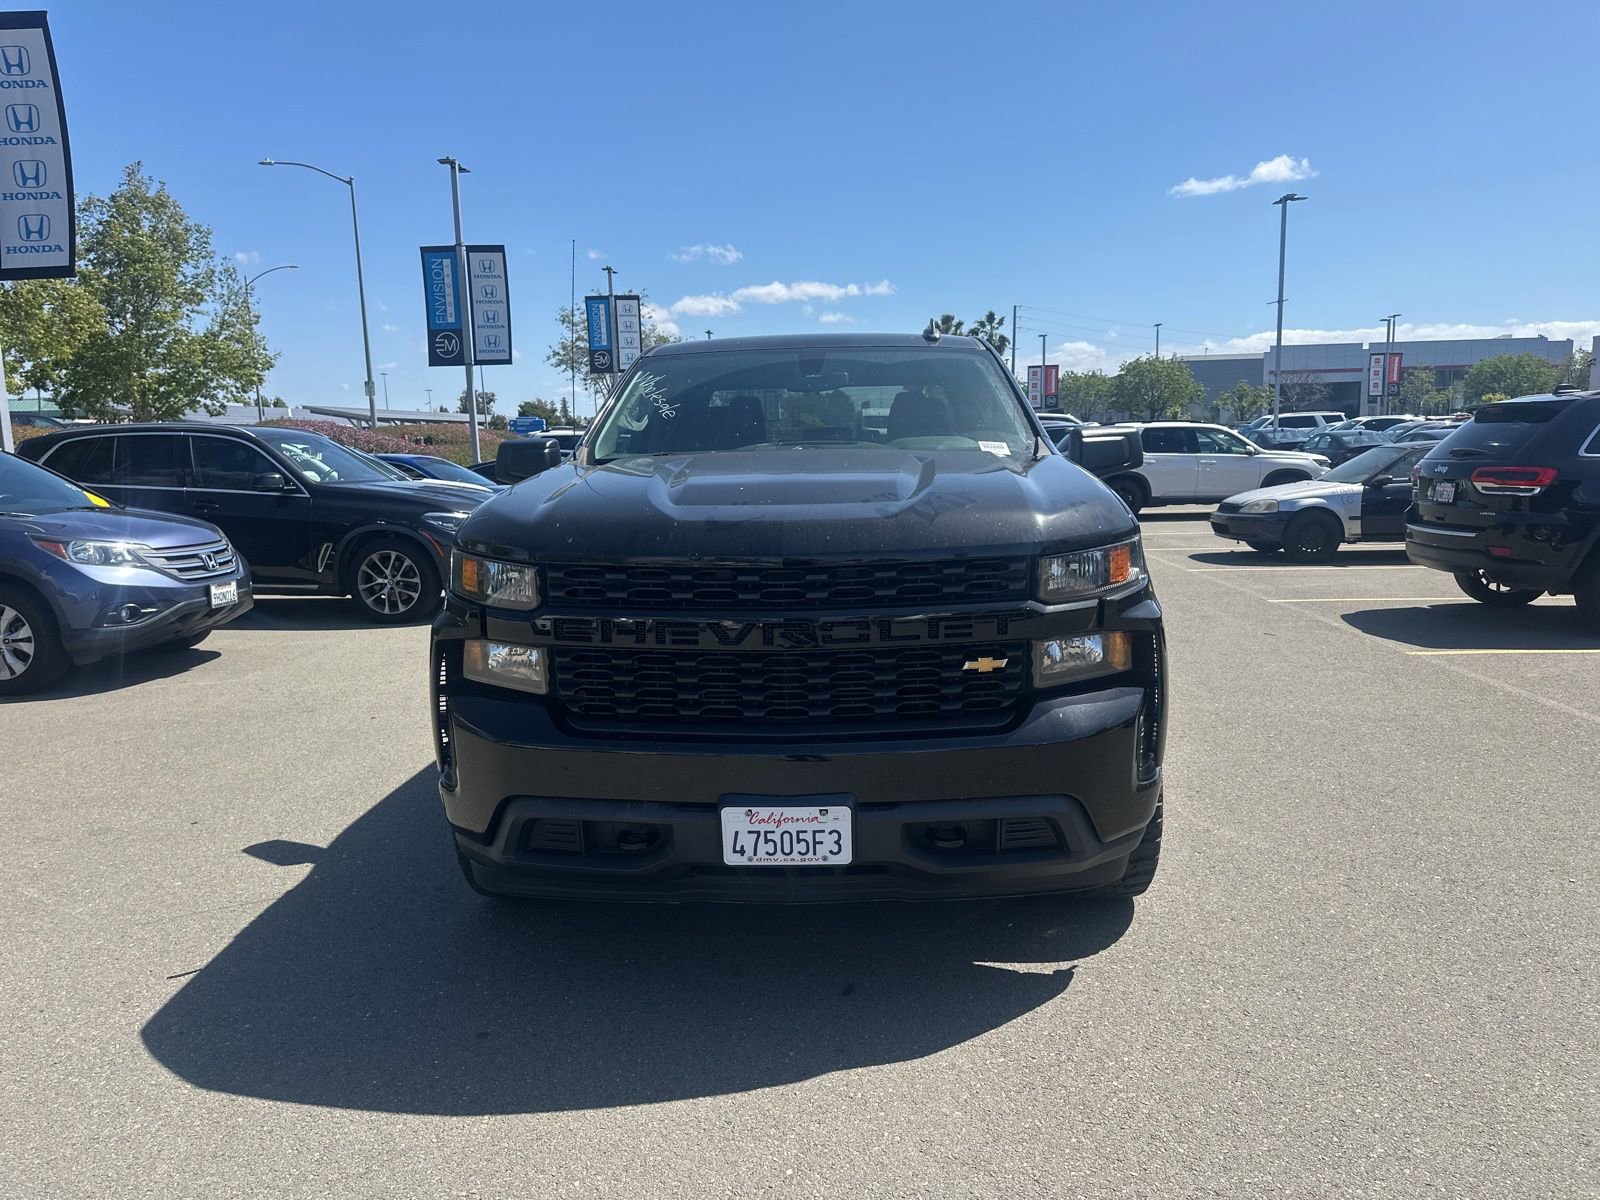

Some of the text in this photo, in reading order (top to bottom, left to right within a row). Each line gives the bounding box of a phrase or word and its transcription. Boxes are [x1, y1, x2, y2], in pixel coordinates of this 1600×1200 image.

[0, 80, 49, 89] ONDA
[2, 191, 63, 201] HONDA
[5, 244, 65, 254] HONDA
[432, 258, 447, 324] ENVISION
[592, 303, 602, 347] ENVISION
[552, 612, 1027, 648] CHEVROLET
[749, 811, 823, 829] California
[732, 829, 842, 857] 47505F3
